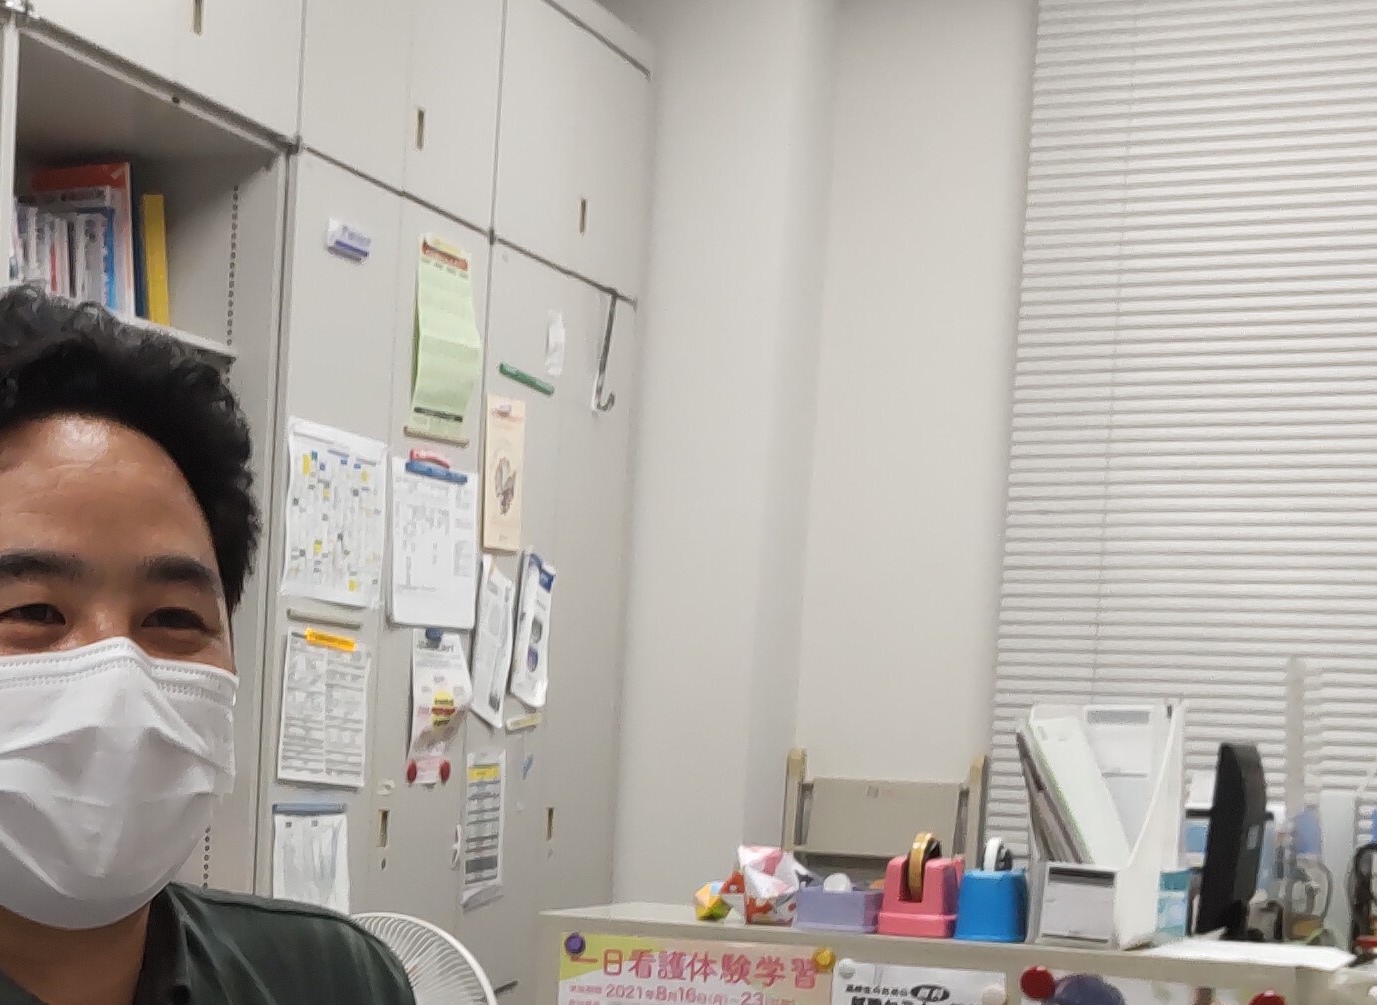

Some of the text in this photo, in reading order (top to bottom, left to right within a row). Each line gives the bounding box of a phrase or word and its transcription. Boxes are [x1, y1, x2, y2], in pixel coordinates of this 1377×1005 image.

[570, 949, 818, 990] 一日看護体験学習
